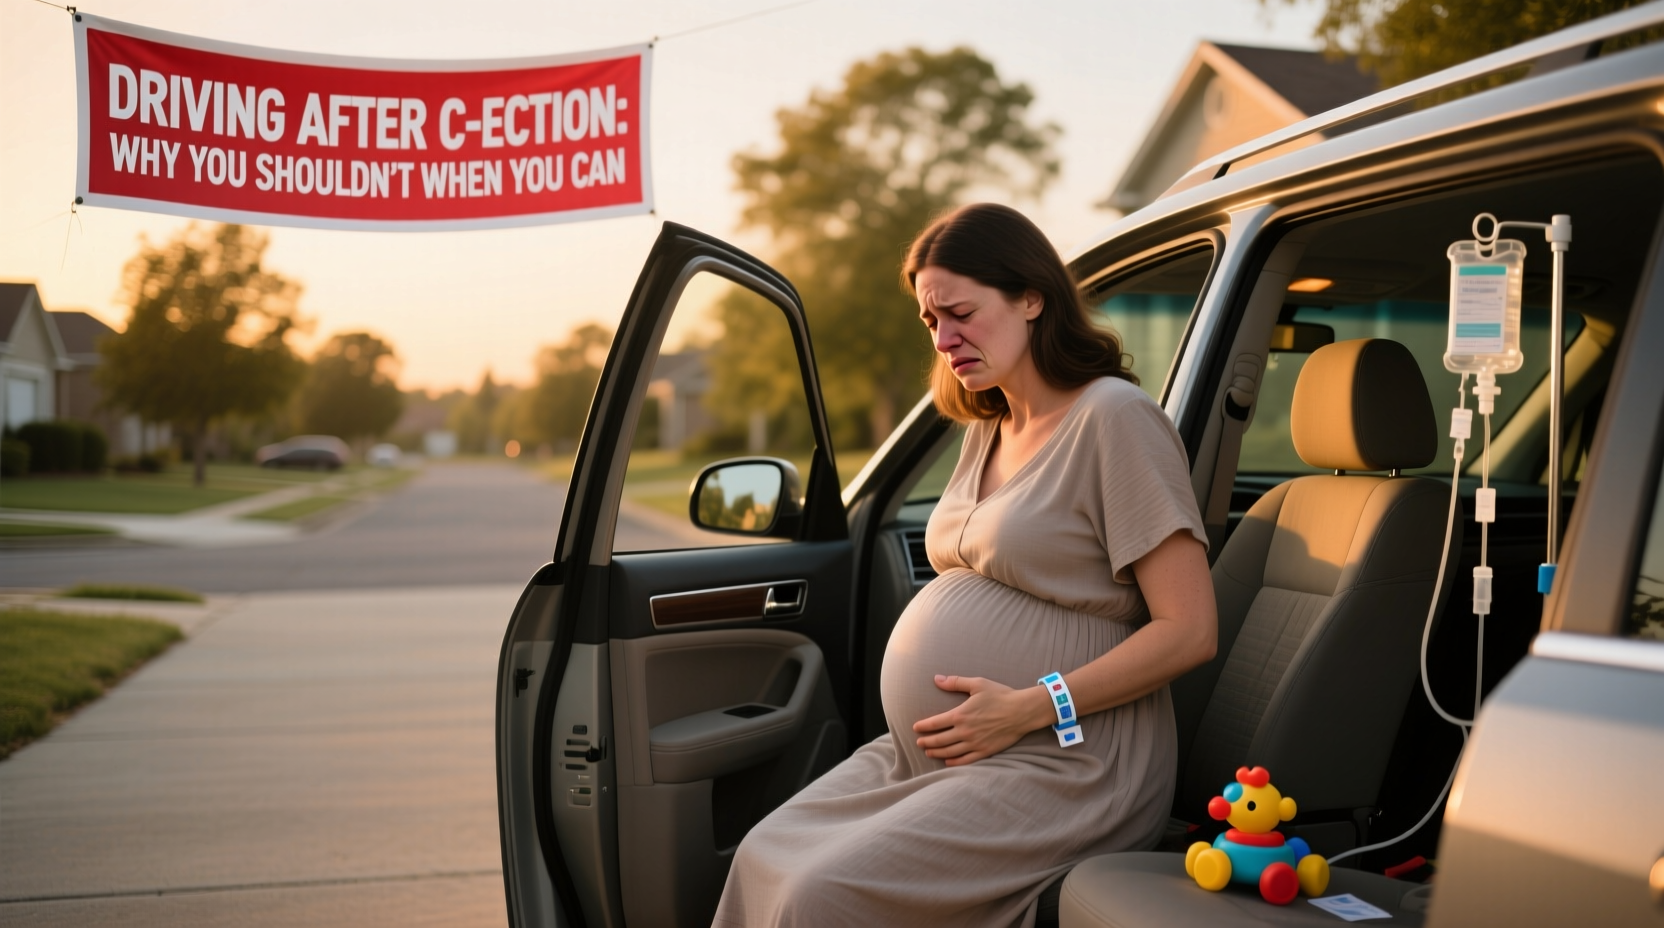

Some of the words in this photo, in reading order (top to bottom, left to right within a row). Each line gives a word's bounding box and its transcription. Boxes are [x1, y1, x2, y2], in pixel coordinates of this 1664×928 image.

[108, 63, 286, 142] DRIVING
[296, 92, 428, 151] AFTER
[438, 84, 629, 151] C-ECTION:
[109, 132, 182, 179] WHY
[188, 144, 247, 188] YOU
[255, 153, 415, 199] SHOULDN’T
[420, 158, 503, 199] WHEN
[508, 155, 564, 195] YOU
[570, 147, 627, 189] CAN
